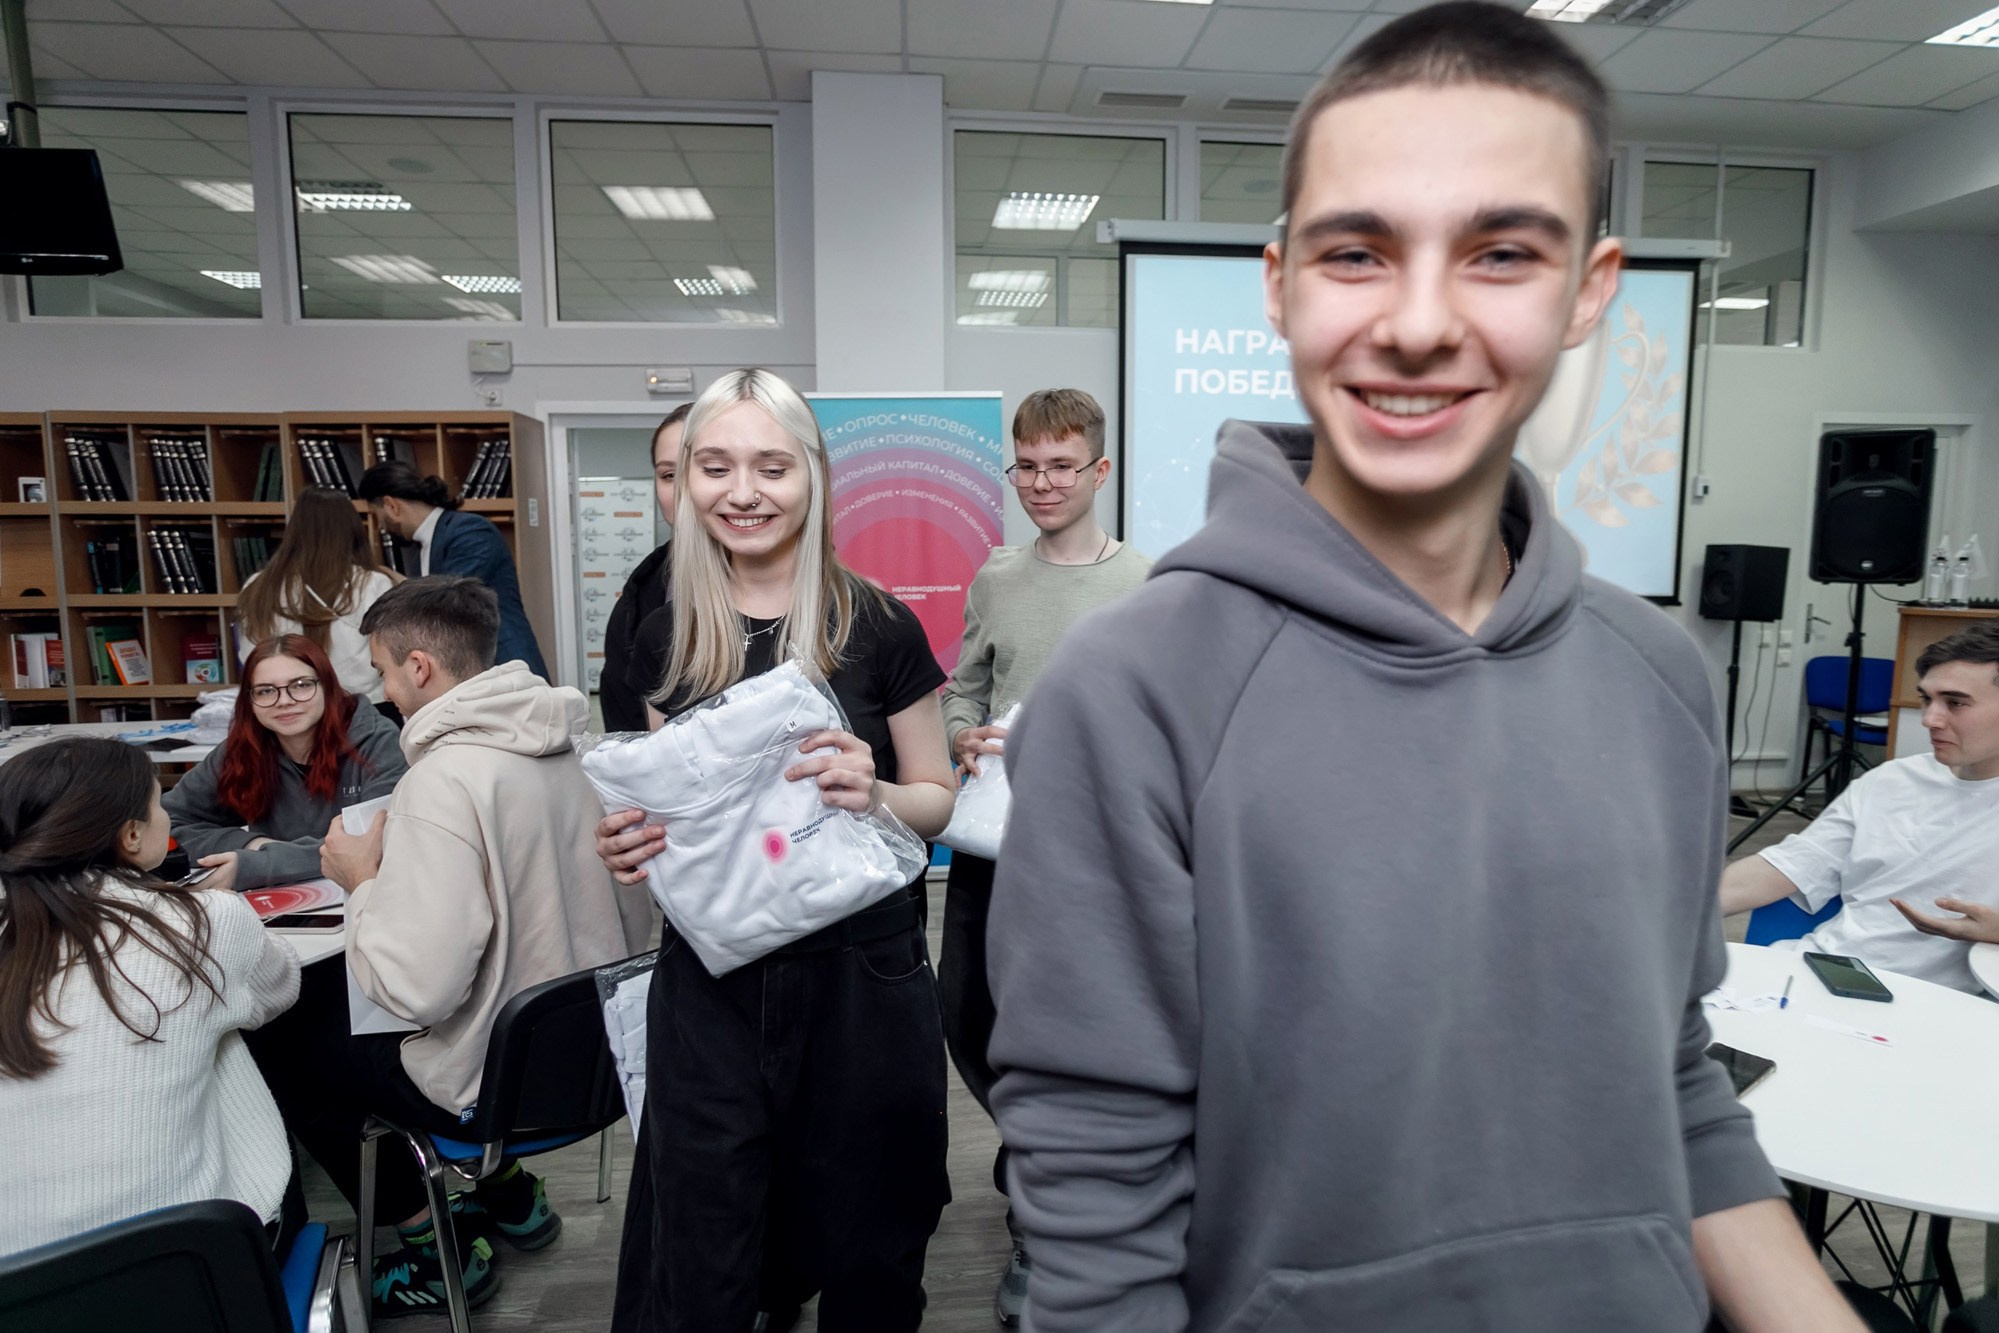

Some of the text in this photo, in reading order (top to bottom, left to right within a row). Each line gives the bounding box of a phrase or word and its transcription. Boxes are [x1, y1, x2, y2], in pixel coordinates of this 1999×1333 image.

[1174, 368, 1296, 400] ПОБЕД
[844, 413, 898, 433] ОПРОС
[908, 413, 977, 440] ЧЕЛОВЕК
[886, 433, 975, 460] ПСИХОЛОГИЯ
[888, 460, 939, 474] КАПИТАЛ
[944, 468, 992, 502] ДОВЕРИЕ
[854, 489, 894, 509] ДОВЕРИЕ
[901, 488, 954, 509] ИЗМЕНЕНИЯ
[957, 508, 991, 545] РАЗВИТИЕ
[892, 584, 962, 593] НЕРАВНОДУШНЫЙ
